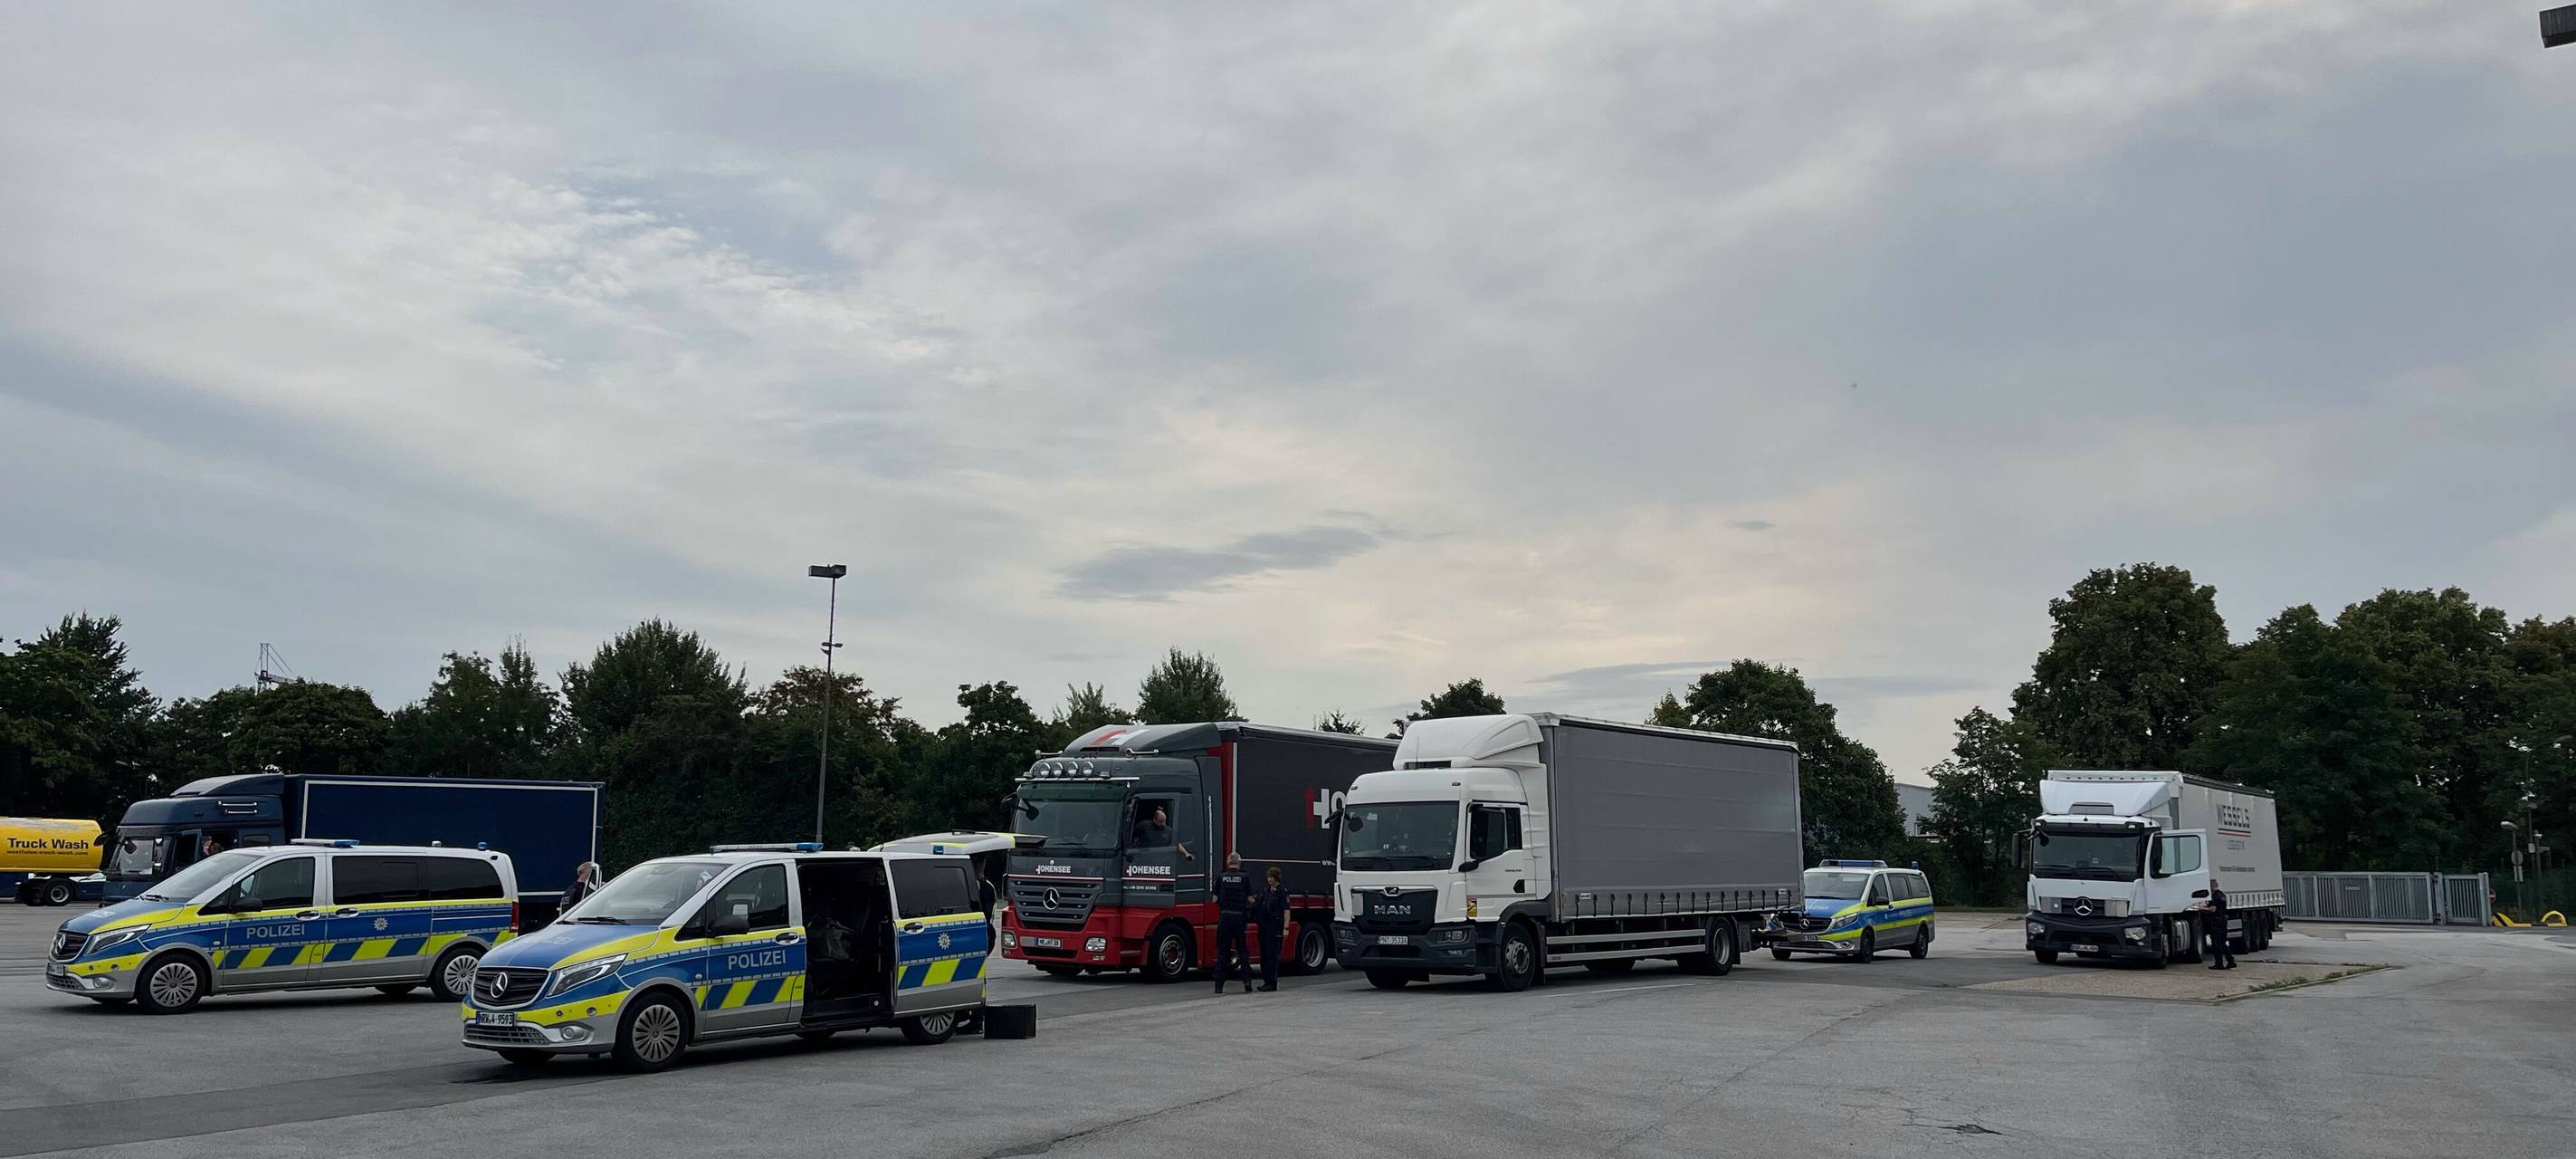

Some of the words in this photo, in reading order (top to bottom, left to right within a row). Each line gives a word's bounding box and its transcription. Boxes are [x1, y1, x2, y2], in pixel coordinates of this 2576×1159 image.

[7, 838, 47, 848] Truck
[52, 838, 89, 849] Wash
[1374, 905, 1411, 915] MAN
[246, 924, 305, 939] POLIZEI
[728, 949, 787, 970] POLIZEI
